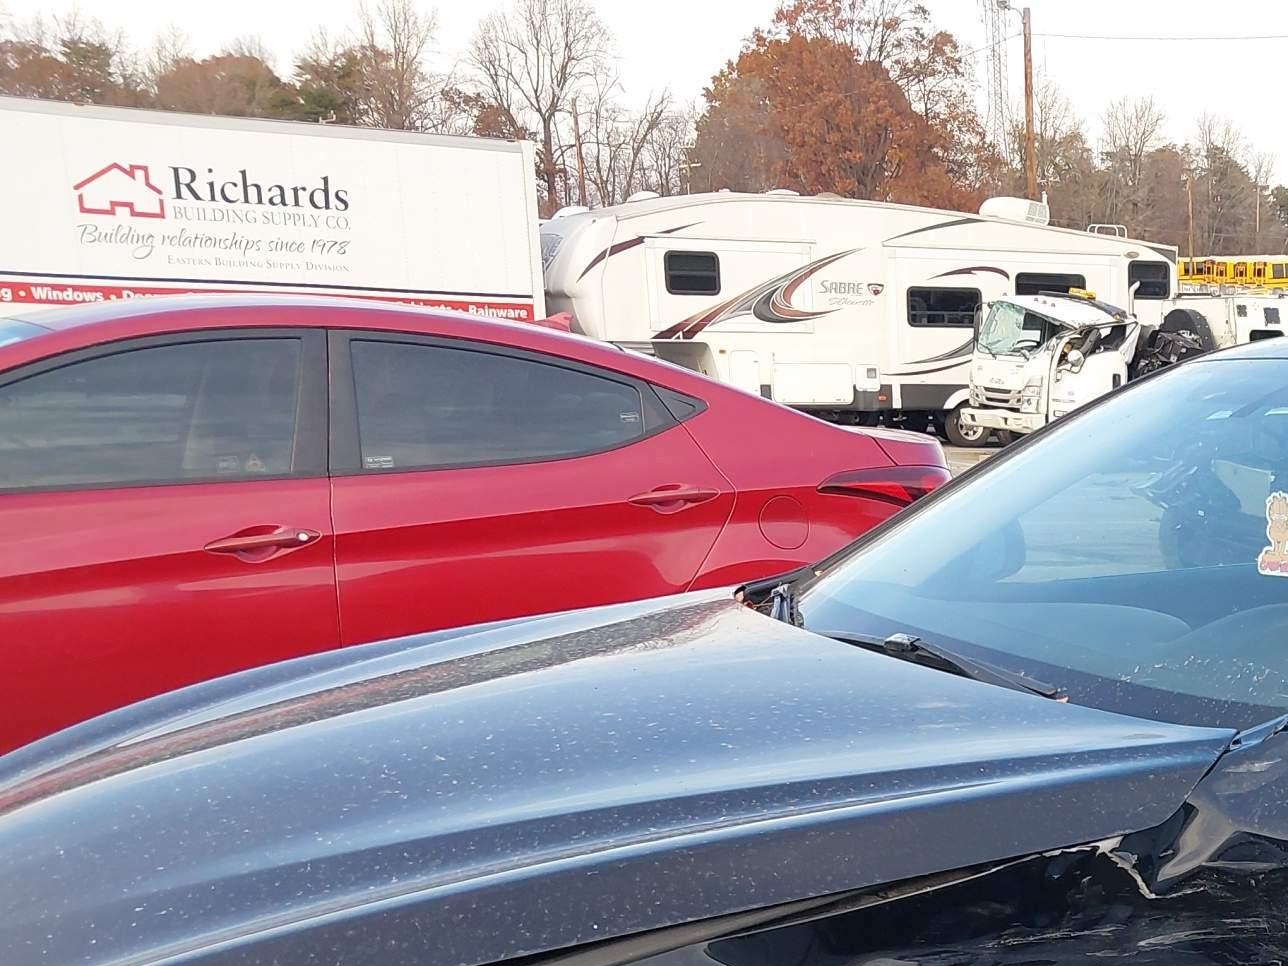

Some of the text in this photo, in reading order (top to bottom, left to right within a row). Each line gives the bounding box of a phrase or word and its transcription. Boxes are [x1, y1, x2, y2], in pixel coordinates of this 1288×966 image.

[168, 165, 349, 212] Richards
[172, 206, 351, 231] BUILDING SUPPLY CO.
[78, 223, 351, 259] Building relationships since 1978
[30, 286, 104, 302] Windows
[819, 280, 864, 295] SABRE
[468, 304, 528, 319] Rainware
